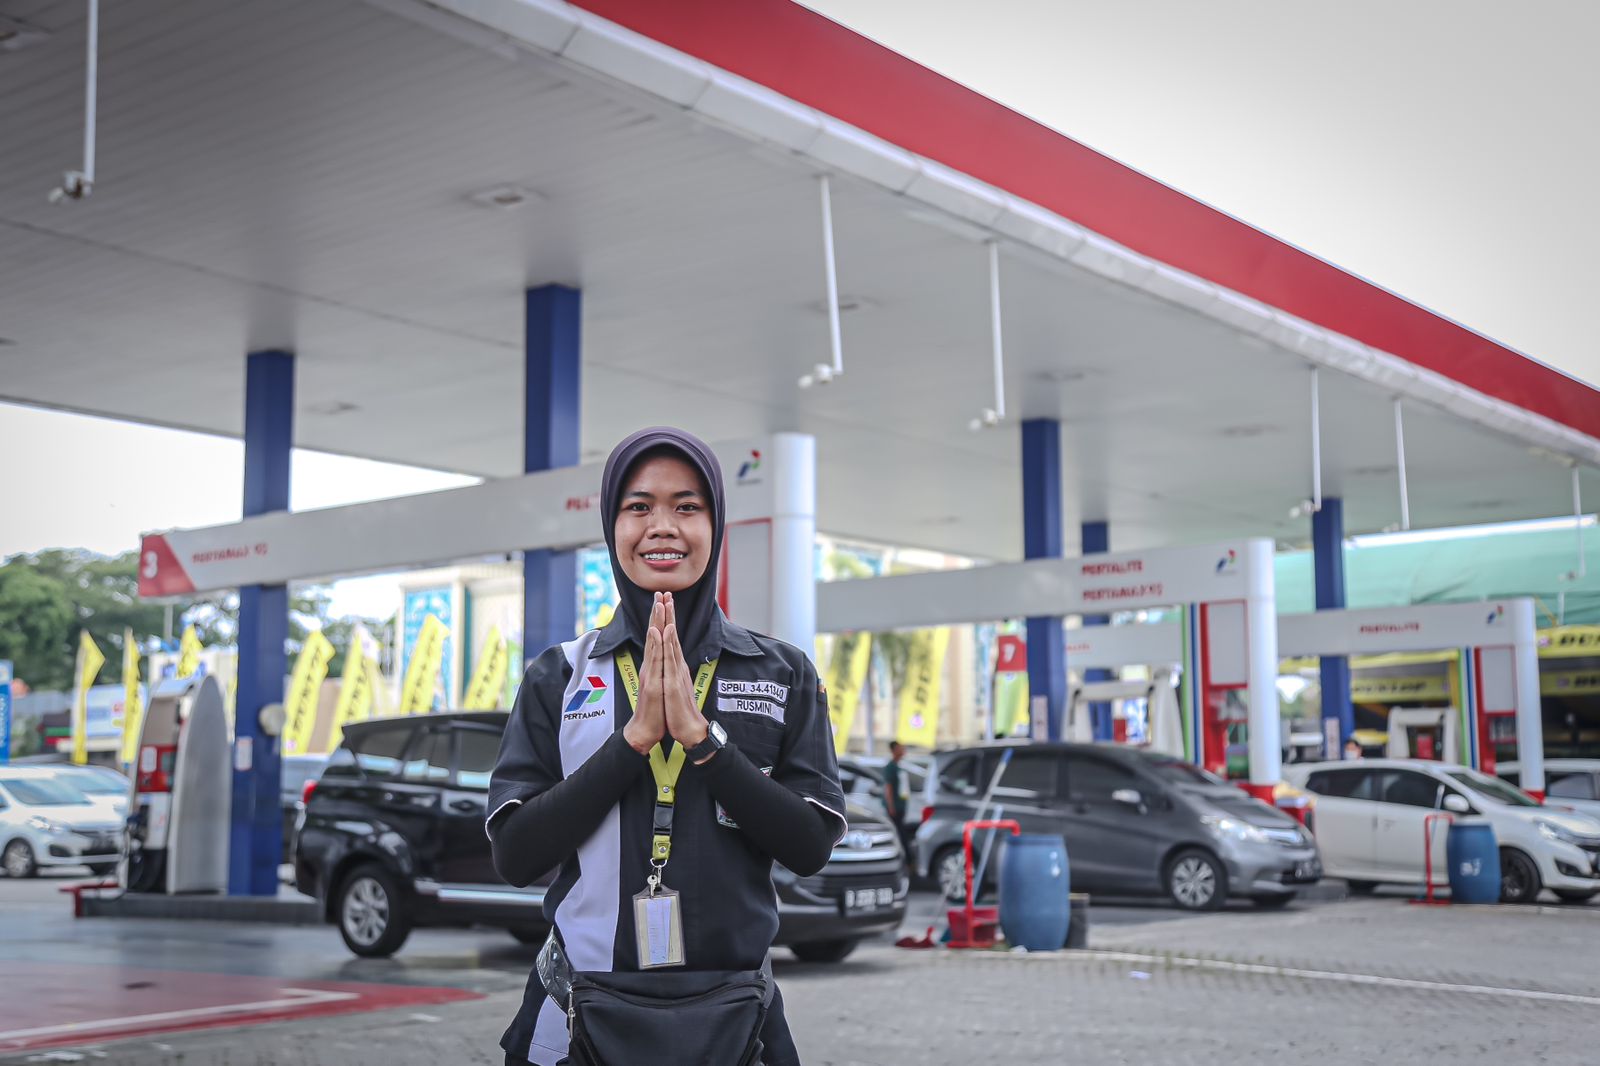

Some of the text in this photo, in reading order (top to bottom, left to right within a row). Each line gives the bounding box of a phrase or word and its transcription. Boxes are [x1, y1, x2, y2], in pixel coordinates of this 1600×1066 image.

[143, 550, 158, 579] 3
[720, 682, 784, 700] SPBU 34.41340
[563, 709, 606, 721] PERTAMINA
[736, 700, 772, 715] RUSMINI
